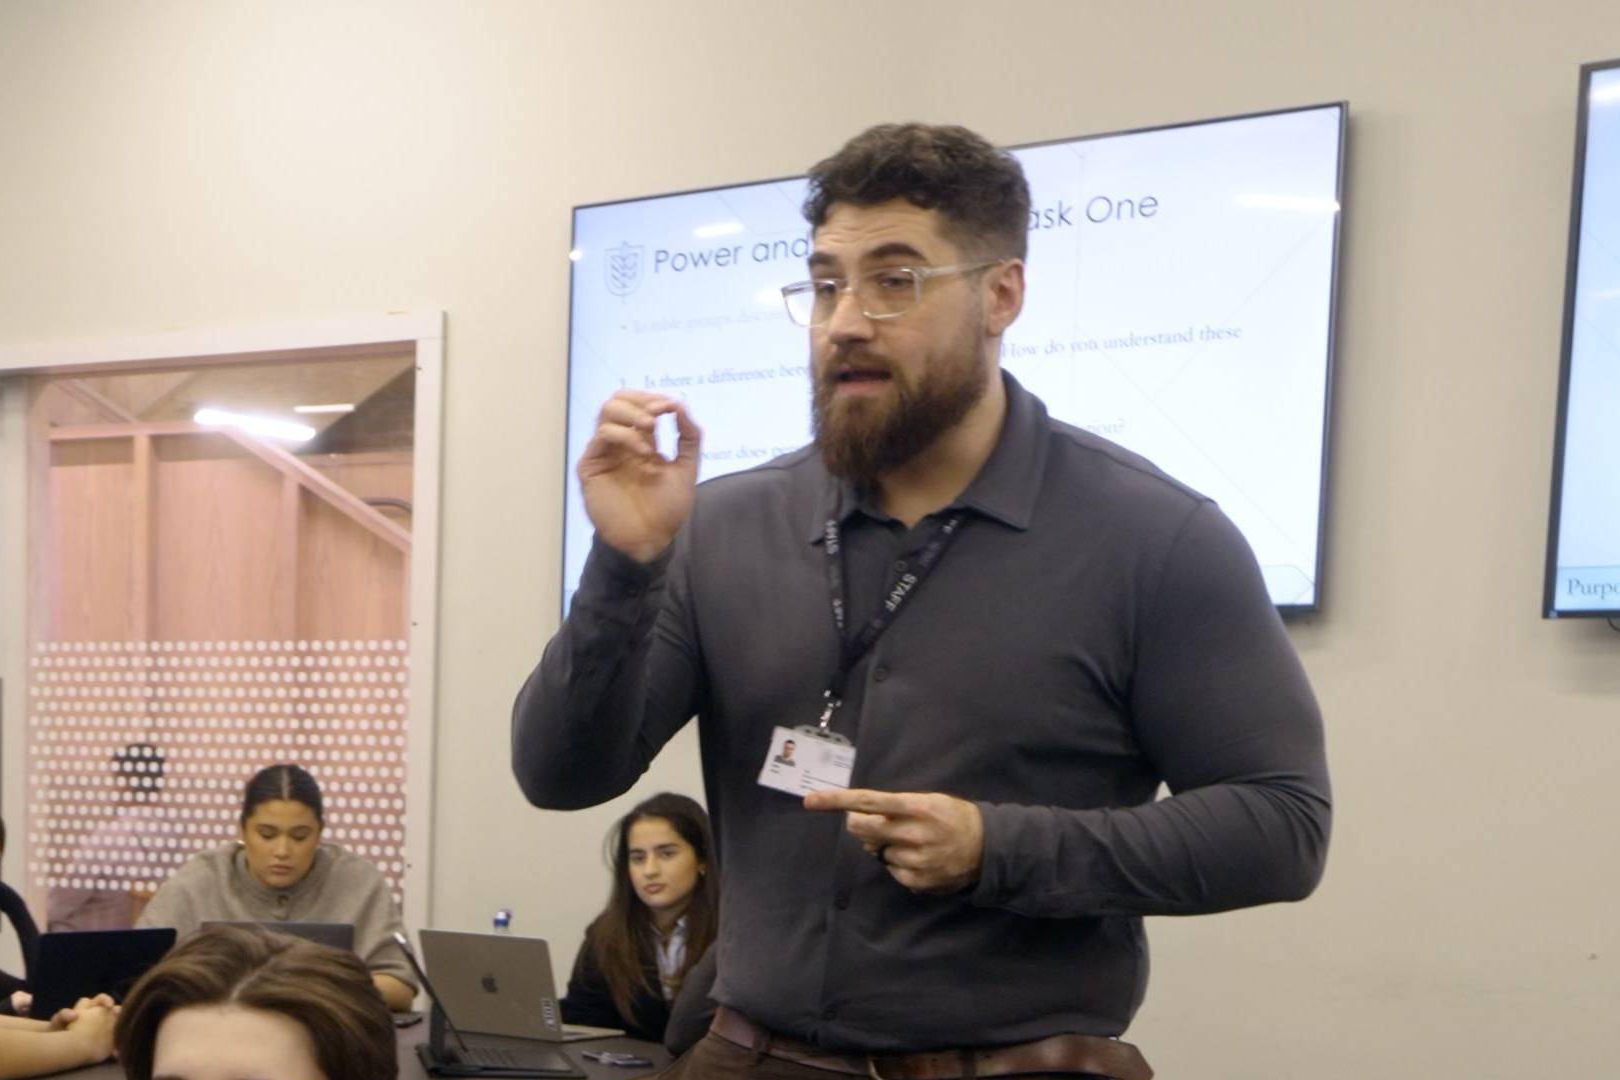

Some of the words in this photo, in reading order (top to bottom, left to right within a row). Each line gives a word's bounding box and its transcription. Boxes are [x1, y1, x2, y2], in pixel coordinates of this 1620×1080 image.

[654, 247, 743, 273] Power
[751, 231, 811, 263] and
[1028, 200, 1073, 231] ask
[1086, 195, 1158, 223] One
[660, 373, 693, 387] there
[708, 367, 776, 384] difference
[1044, 339, 1066, 355] do
[1070, 341, 1099, 357] you
[1103, 327, 1194, 350] understand
[1198, 324, 1243, 342] these
[885, 573, 918, 612] STAFF
